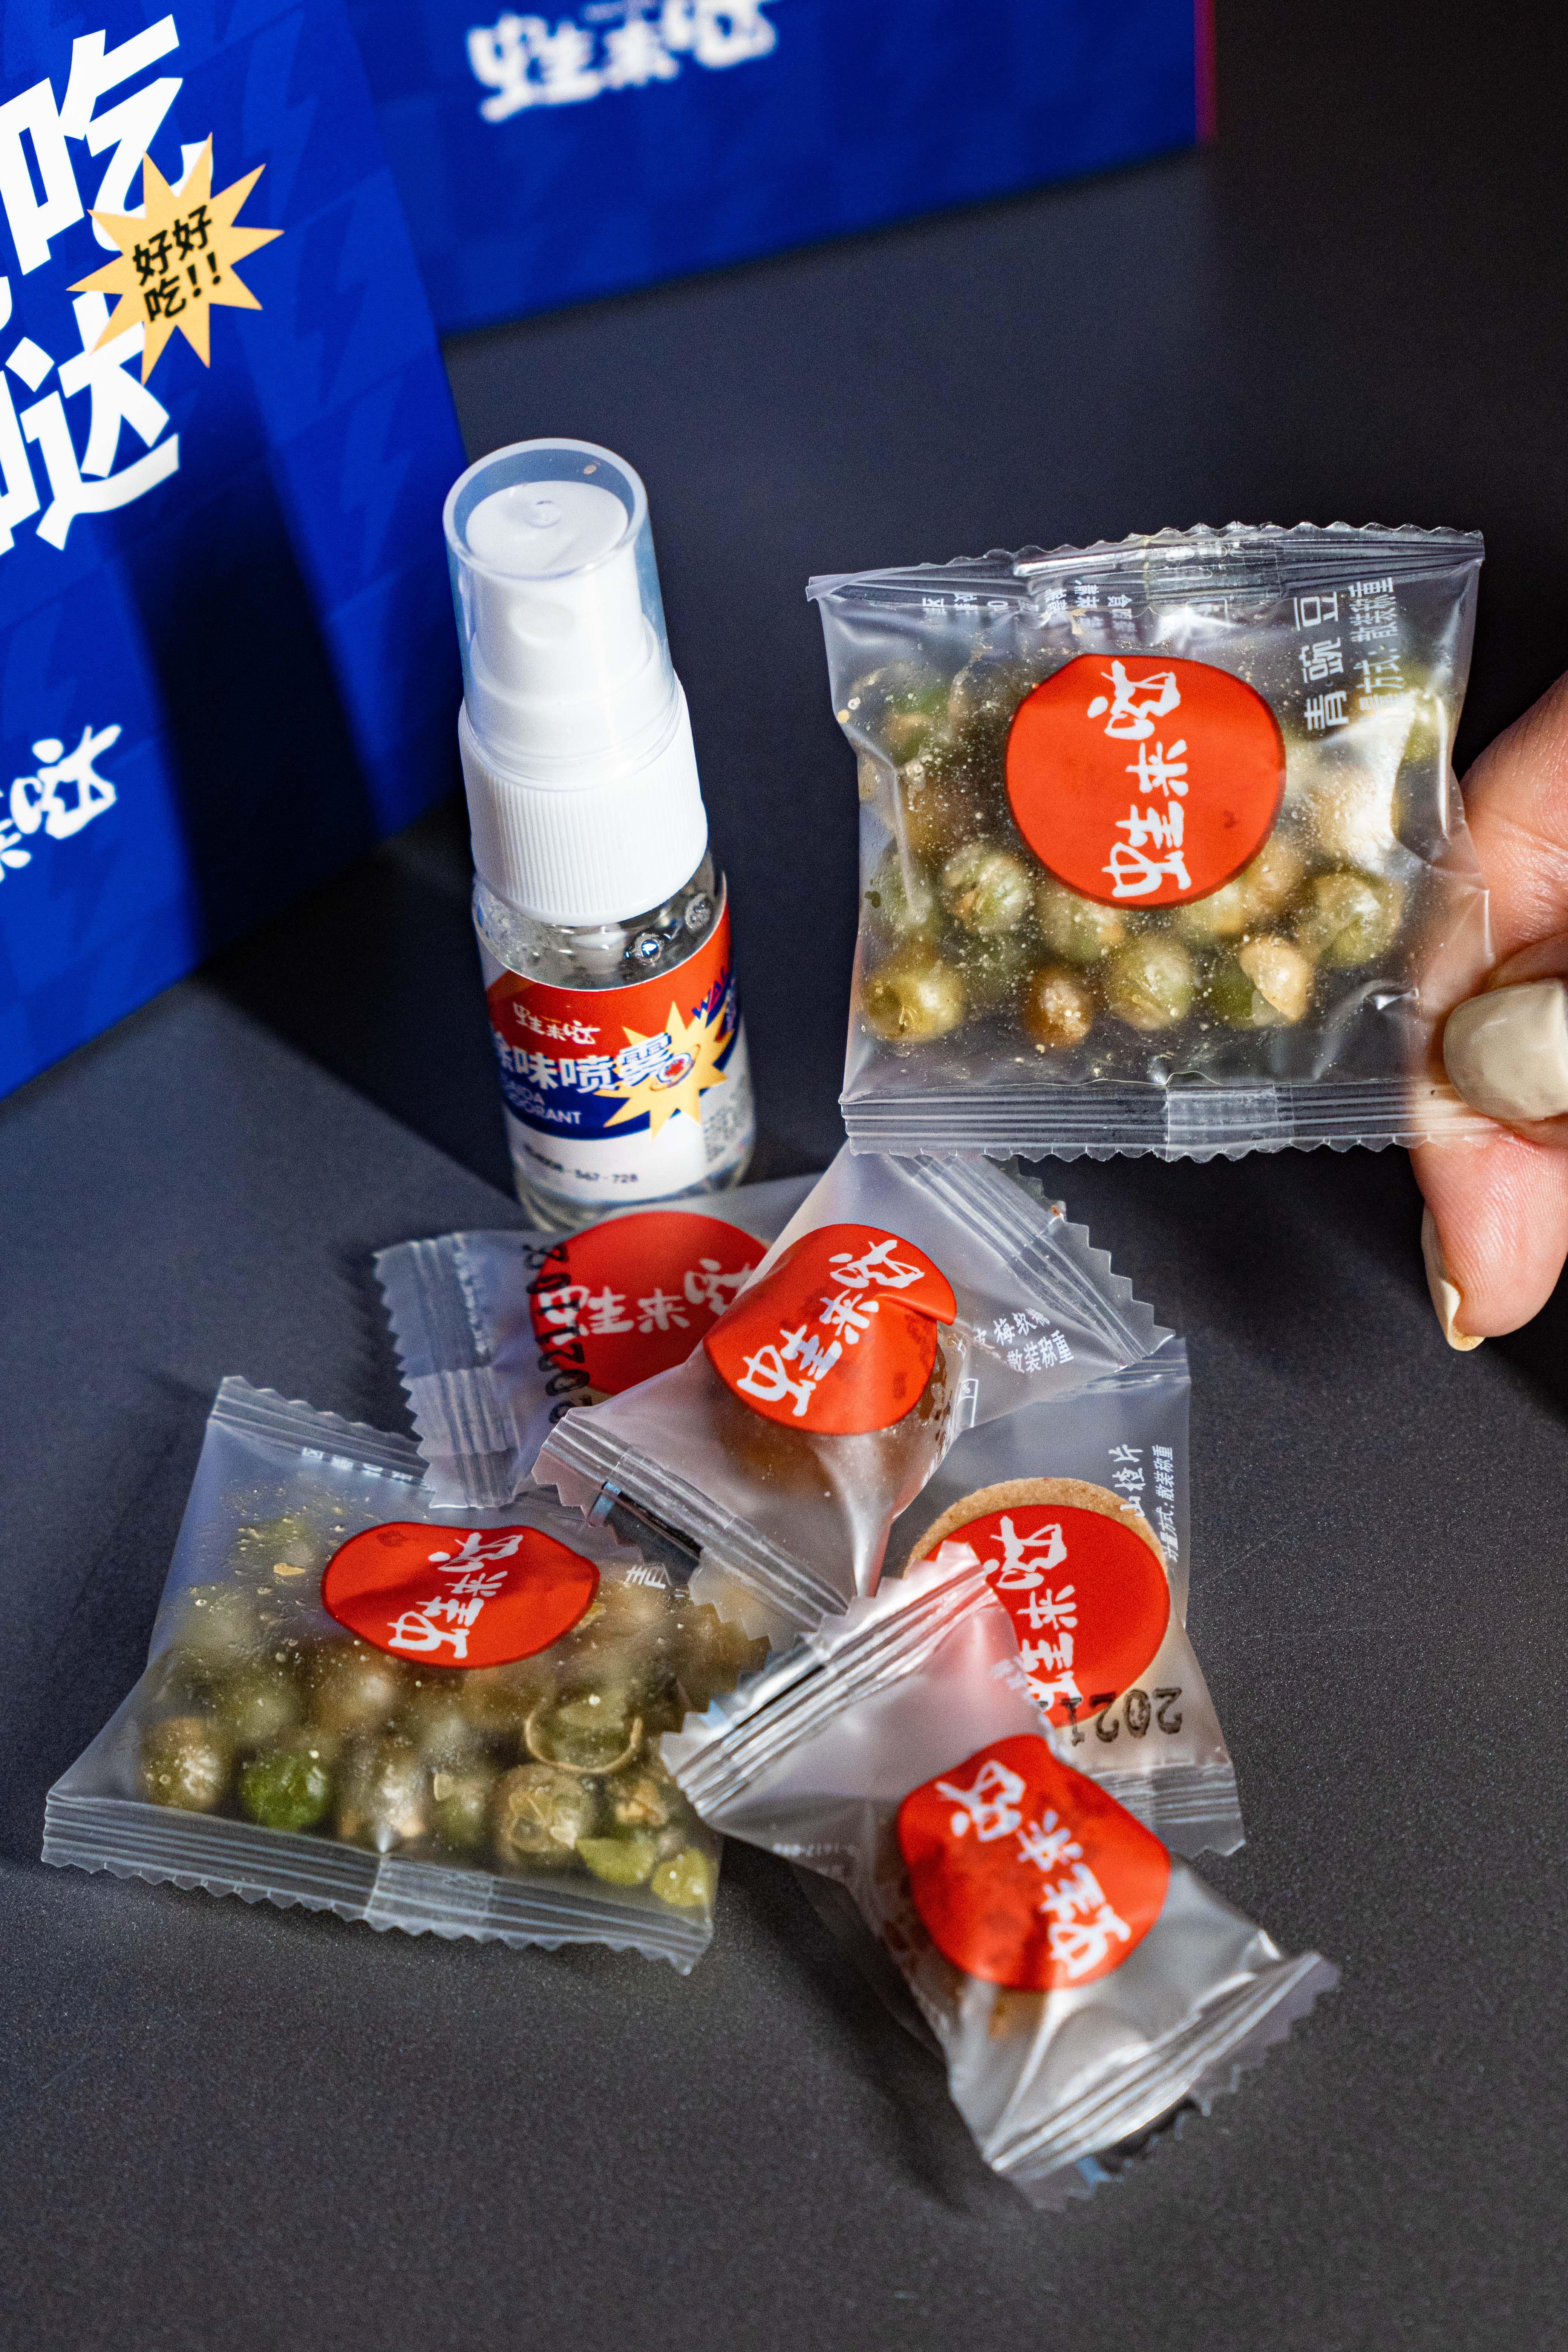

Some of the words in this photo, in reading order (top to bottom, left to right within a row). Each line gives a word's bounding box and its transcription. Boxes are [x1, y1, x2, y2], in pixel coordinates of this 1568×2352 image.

[133, 205, 213, 286] 好好
[1294, 591, 1349, 730] 青豌豆
[1087, 660, 1192, 898] 蛙来哒
[737, 1239, 924, 1416] 蛙来哒
[1108, 1444, 1146, 1517] 山楂片
[388, 1532, 524, 1658] 蛙来哒
[1037, 1688, 1182, 1747] 2021
[936, 1759, 1132, 1979] 蛙来哒
